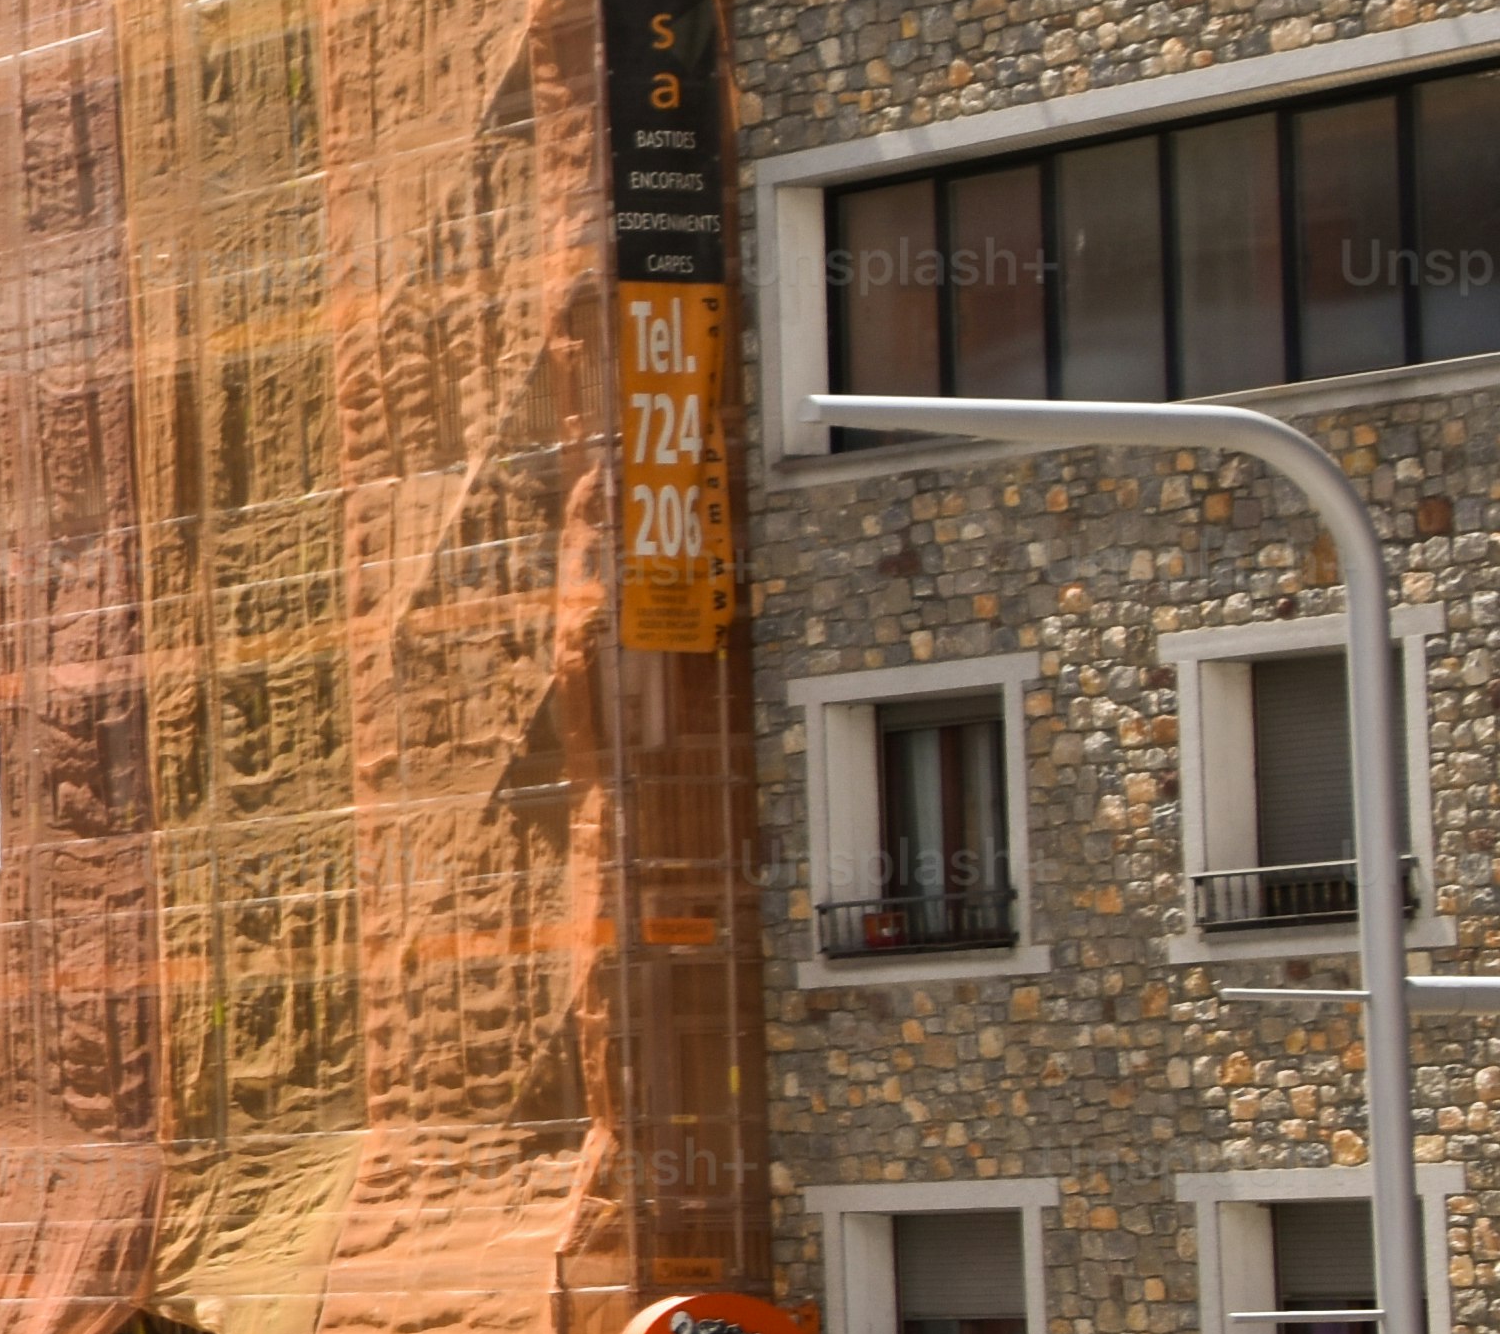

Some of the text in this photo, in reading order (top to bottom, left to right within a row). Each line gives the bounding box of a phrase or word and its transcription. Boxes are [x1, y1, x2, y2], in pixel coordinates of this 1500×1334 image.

[636, 129, 696, 149] BASTIDES
[630, 170, 704, 191] ENCOFRATS
[629, 297, 697, 373] Tel.
[631, 393, 703, 464] 724
[633, 485, 703, 557] 206
